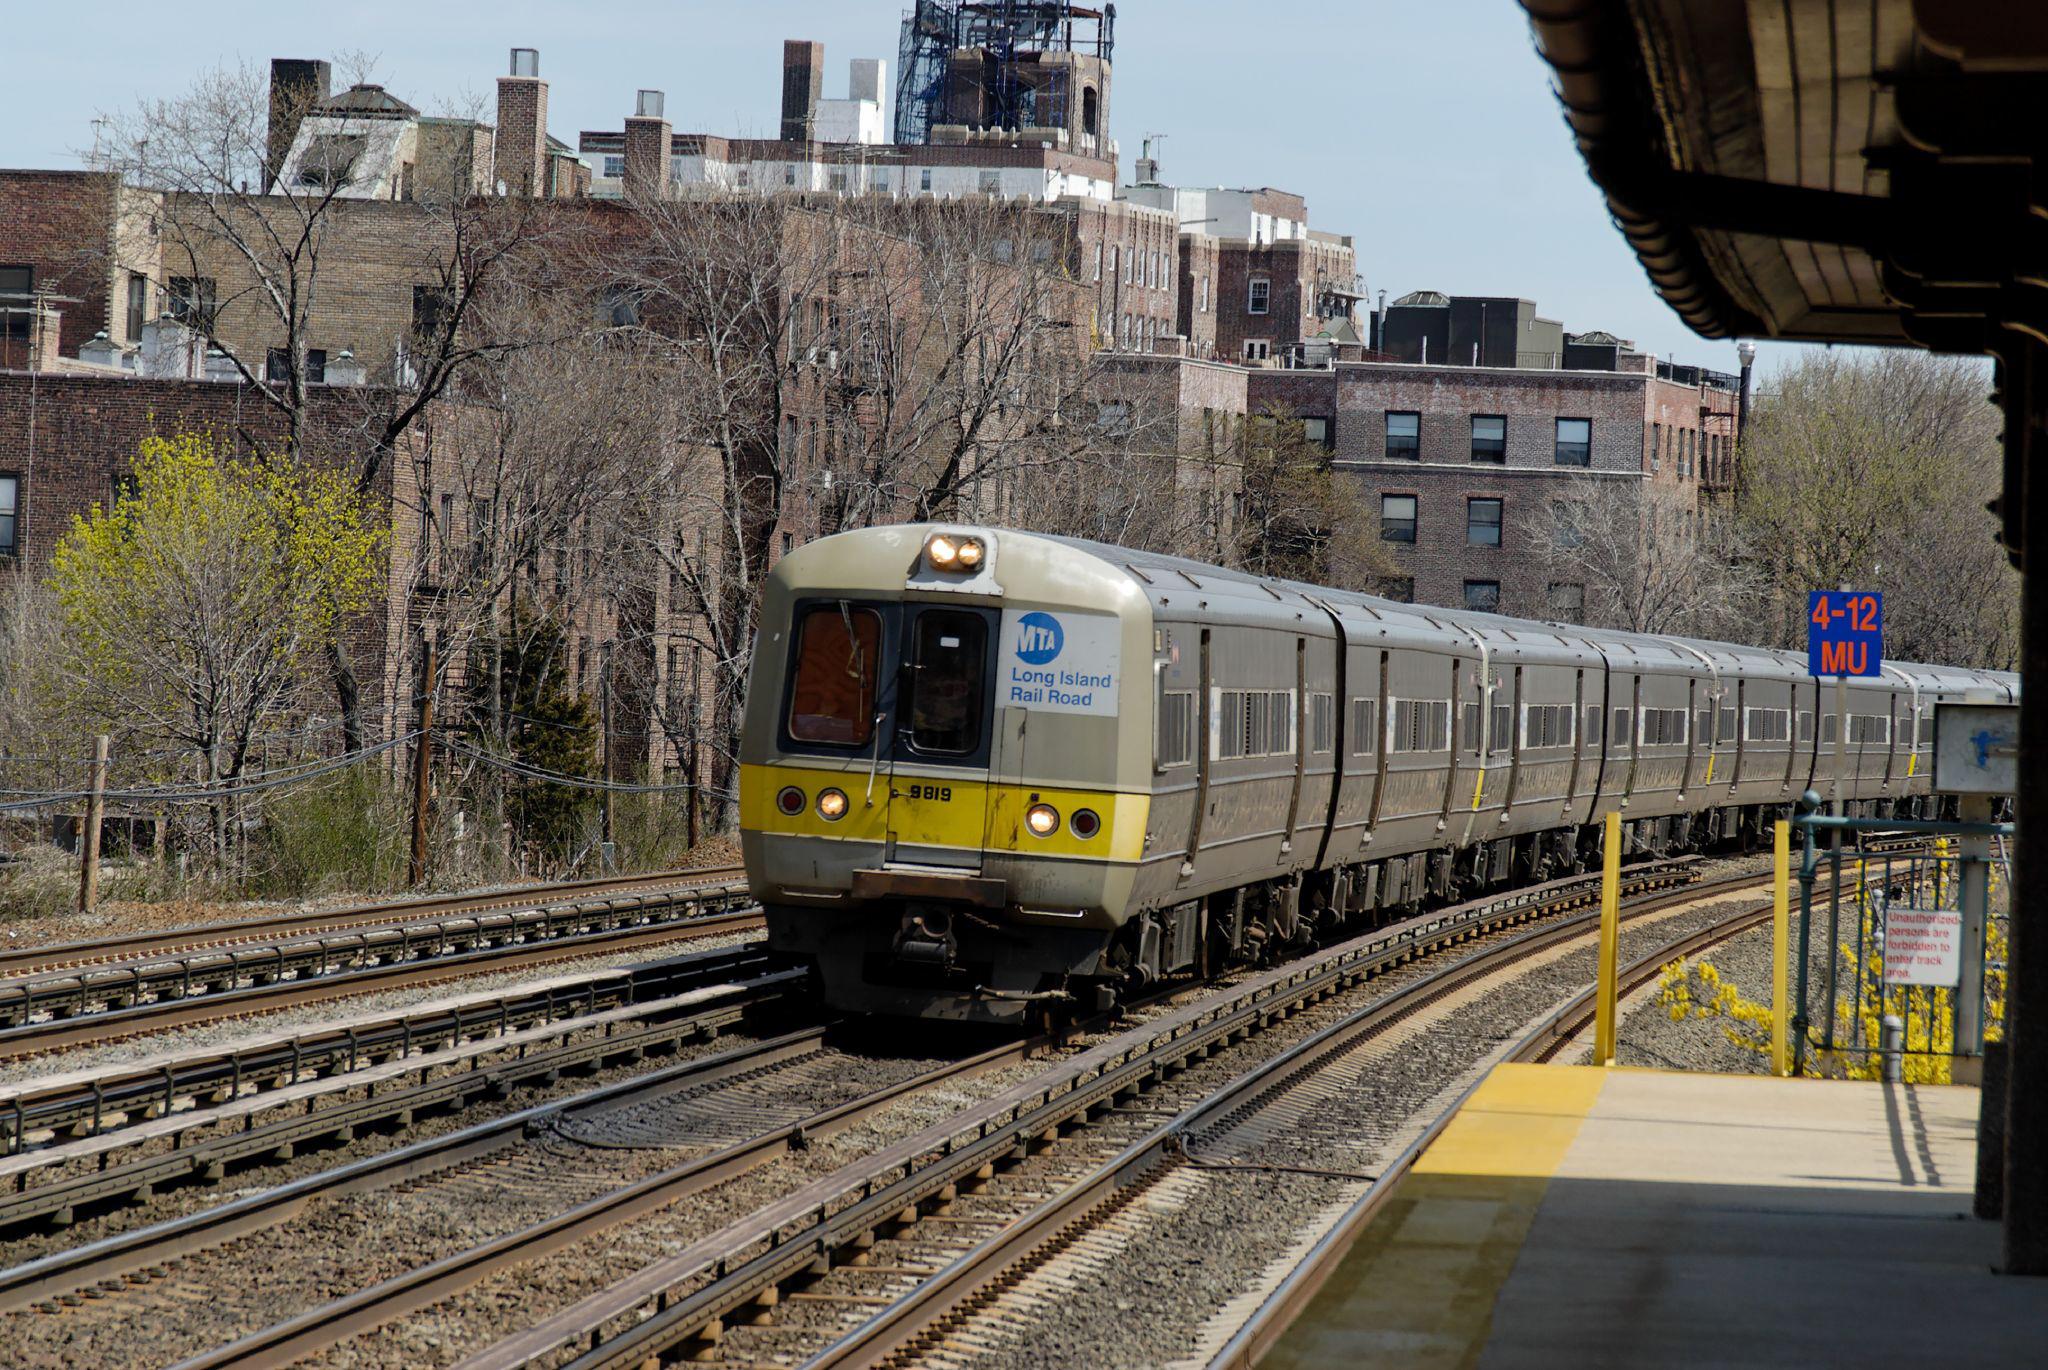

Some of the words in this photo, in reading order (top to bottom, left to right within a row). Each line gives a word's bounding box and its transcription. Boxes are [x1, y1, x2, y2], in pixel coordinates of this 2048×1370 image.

[1812, 595, 1877, 631] 4-12
[1016, 621, 1055, 653] MTA
[1821, 641, 1867, 674] MU
[1012, 667, 1055, 687] Long
[1060, 671, 1111, 688] Island
[1011, 686, 1042, 702] Rail
[1048, 690, 1092, 706] Road
[910, 785, 951, 802] 9819
[1889, 912, 1959, 925] Unauthorized
[1888, 928, 1929, 938] persons
[1933, 930, 1949, 938] are
[1887, 941, 1936, 952] forbidden
[1940, 943, 1950, 953] to
[1886, 955, 1913, 965] enter
[1917, 955, 1942, 966] track
